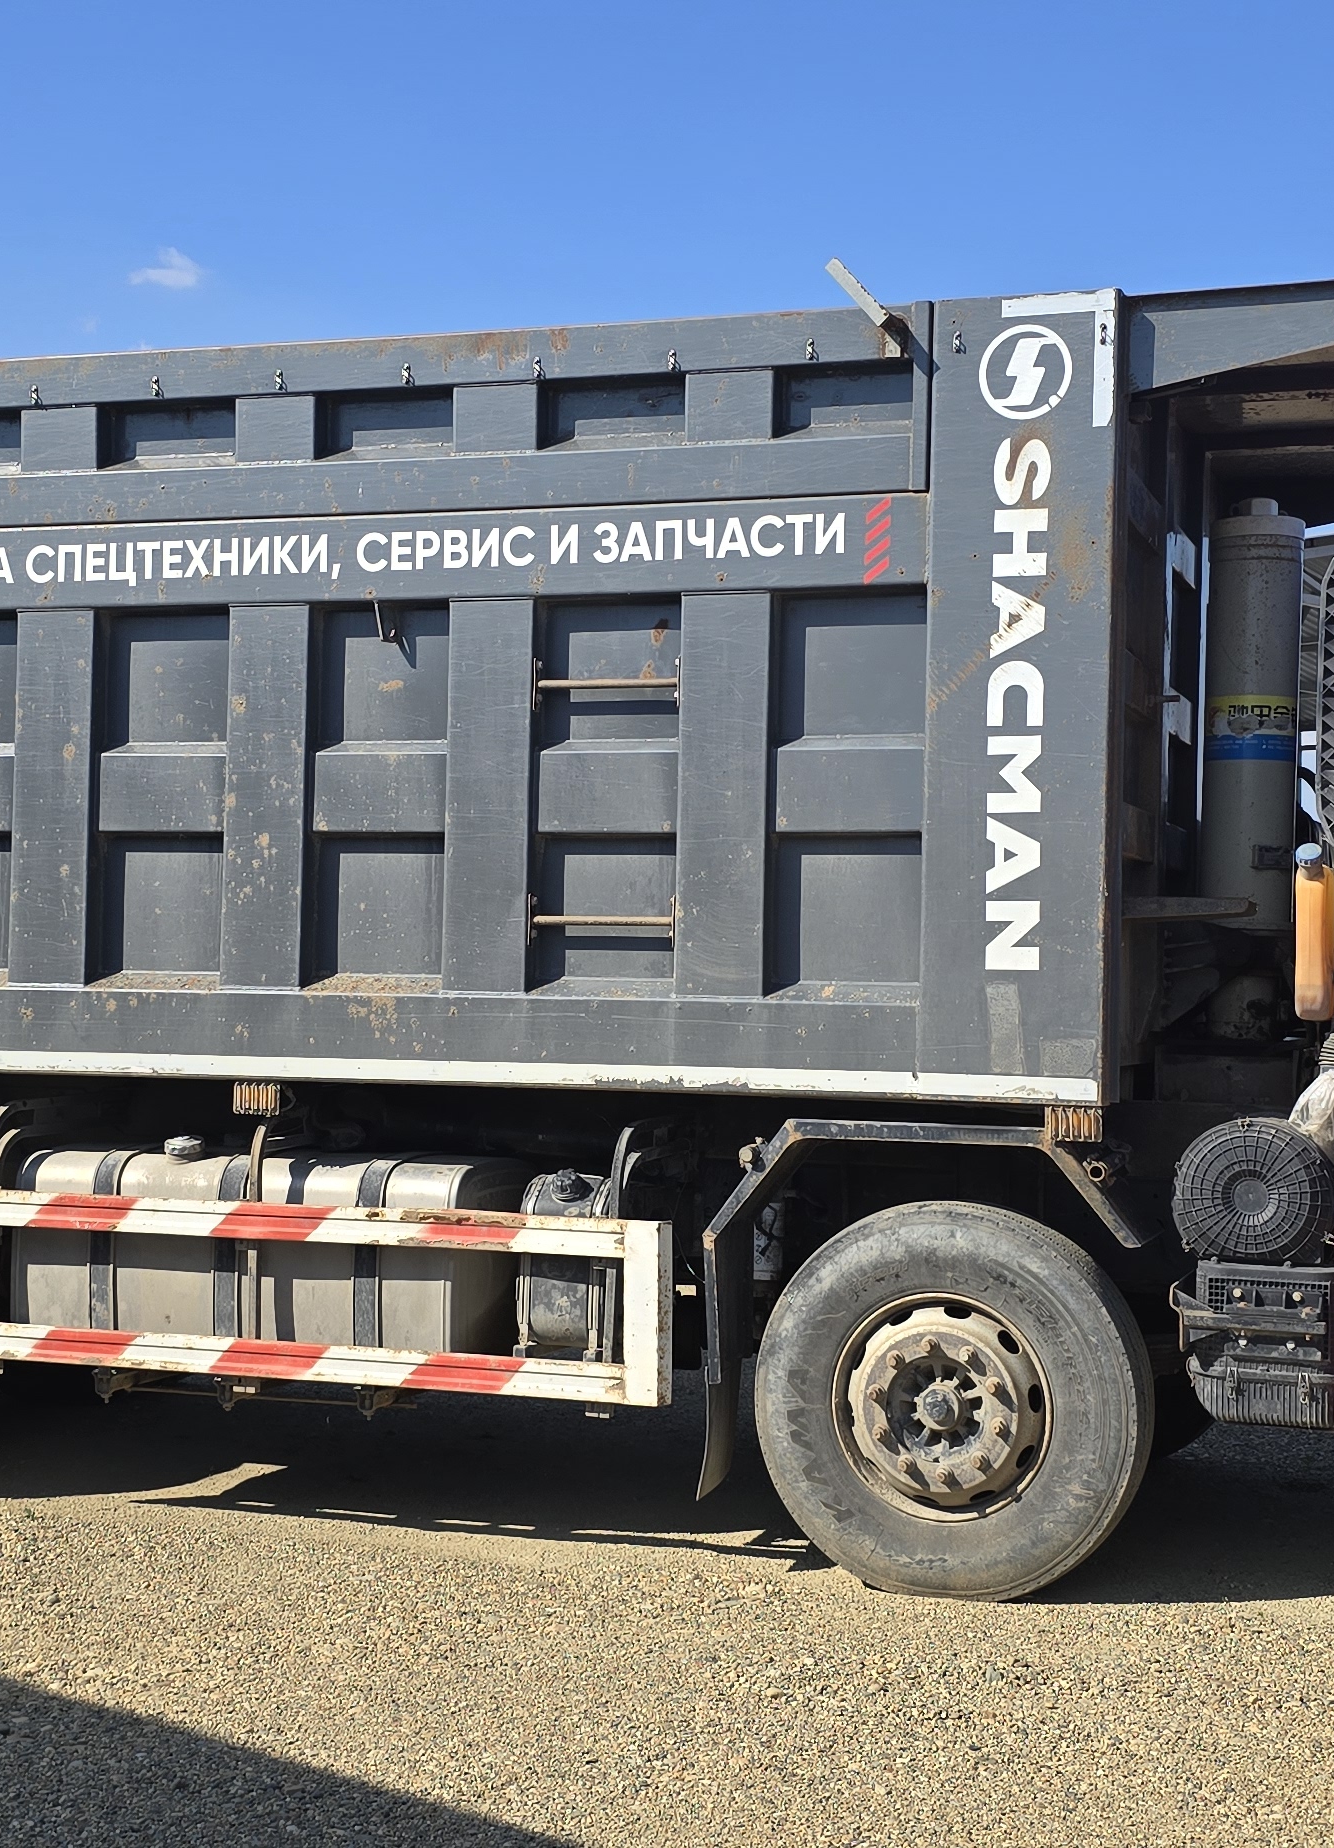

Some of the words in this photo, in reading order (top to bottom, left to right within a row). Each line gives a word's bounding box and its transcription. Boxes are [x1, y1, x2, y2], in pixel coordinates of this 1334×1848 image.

[25, 533, 343, 587] СПЕЦТЕХНИКИ,
[356, 526, 535, 572] СЕРВИС
[549, 523, 579, 565] И
[593, 513, 846, 564] ЗАПЧАСТИ
[985, 437, 1052, 971] SHACMAN
